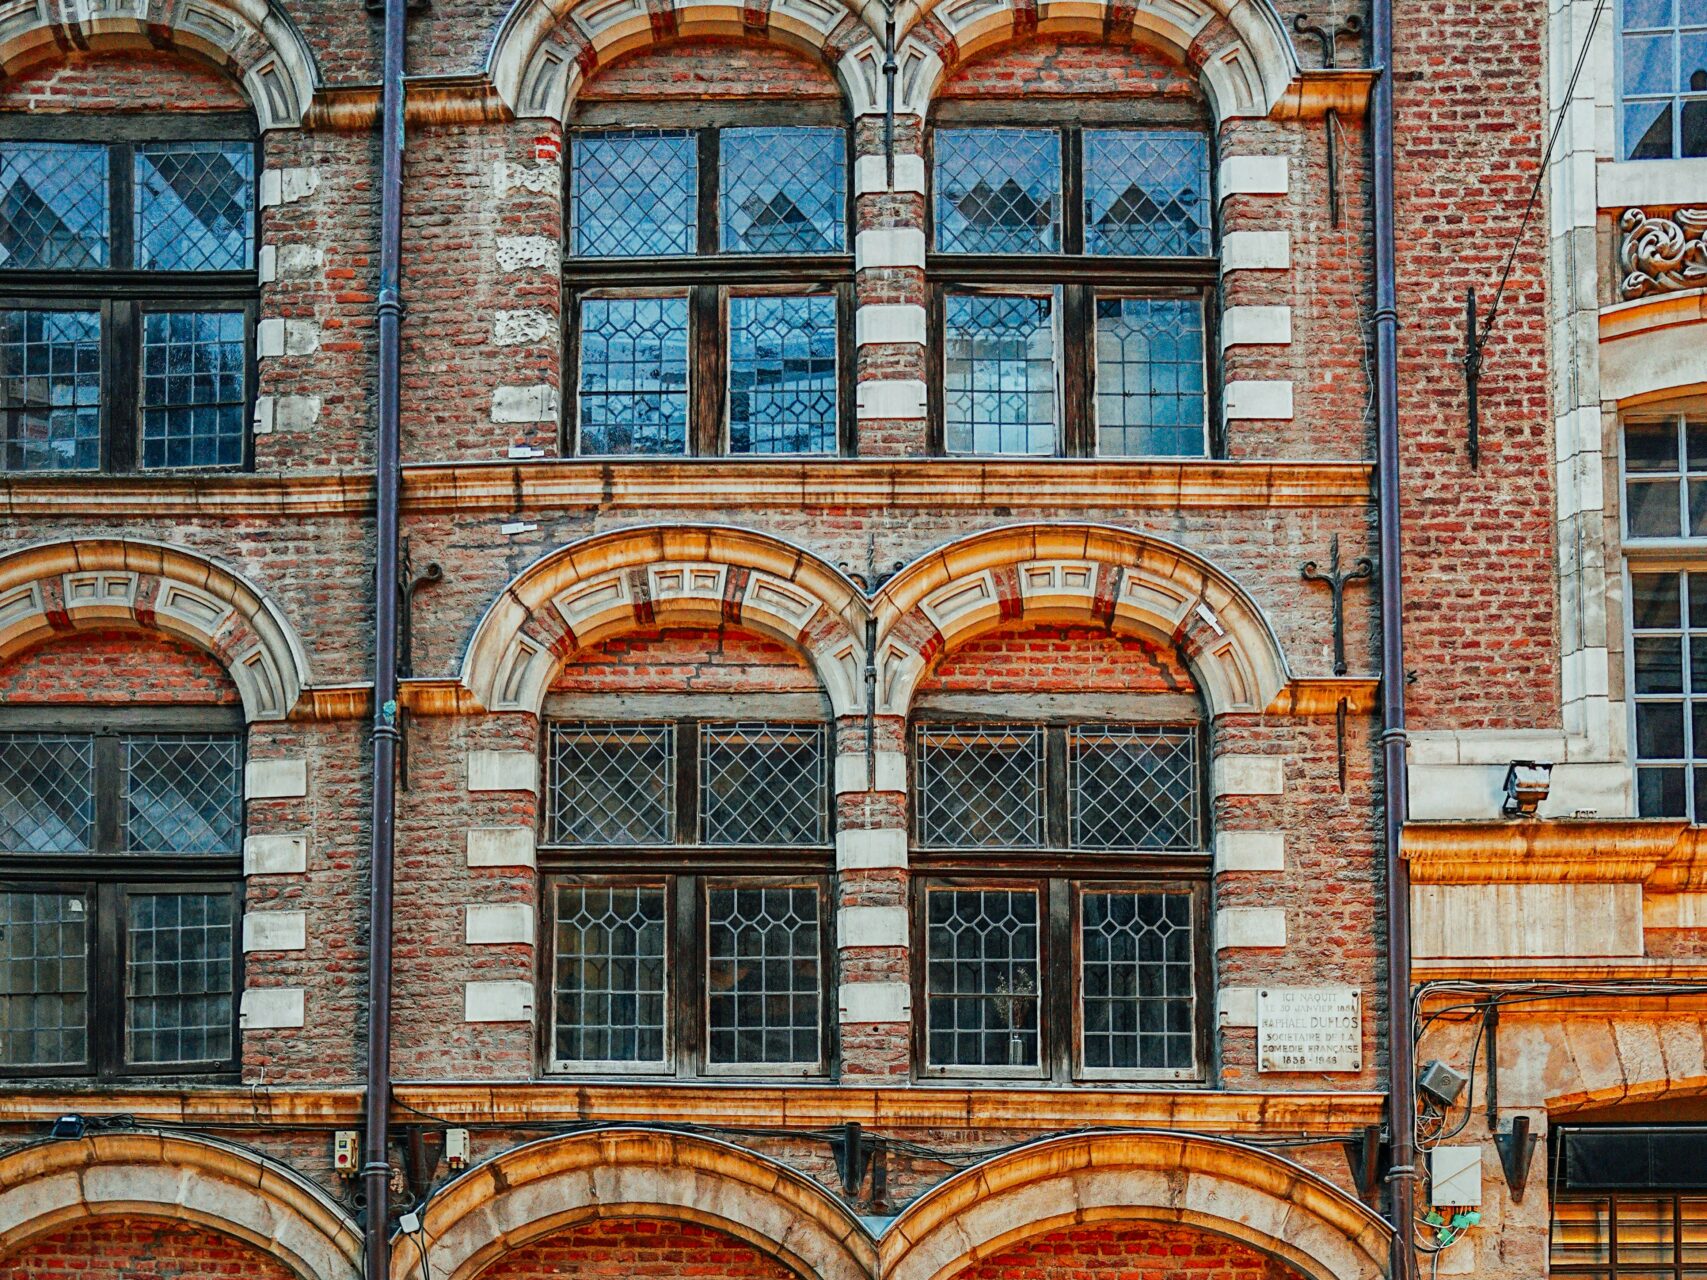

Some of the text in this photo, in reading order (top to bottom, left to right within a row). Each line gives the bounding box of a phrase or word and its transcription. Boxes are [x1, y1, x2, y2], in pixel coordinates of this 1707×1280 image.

[1282, 993, 1337, 1002] ICI NAQUIT
[1310, 1016, 1359, 1029] DUFLOS
[1308, 1045, 1359, 1054] FRANÇAISE
